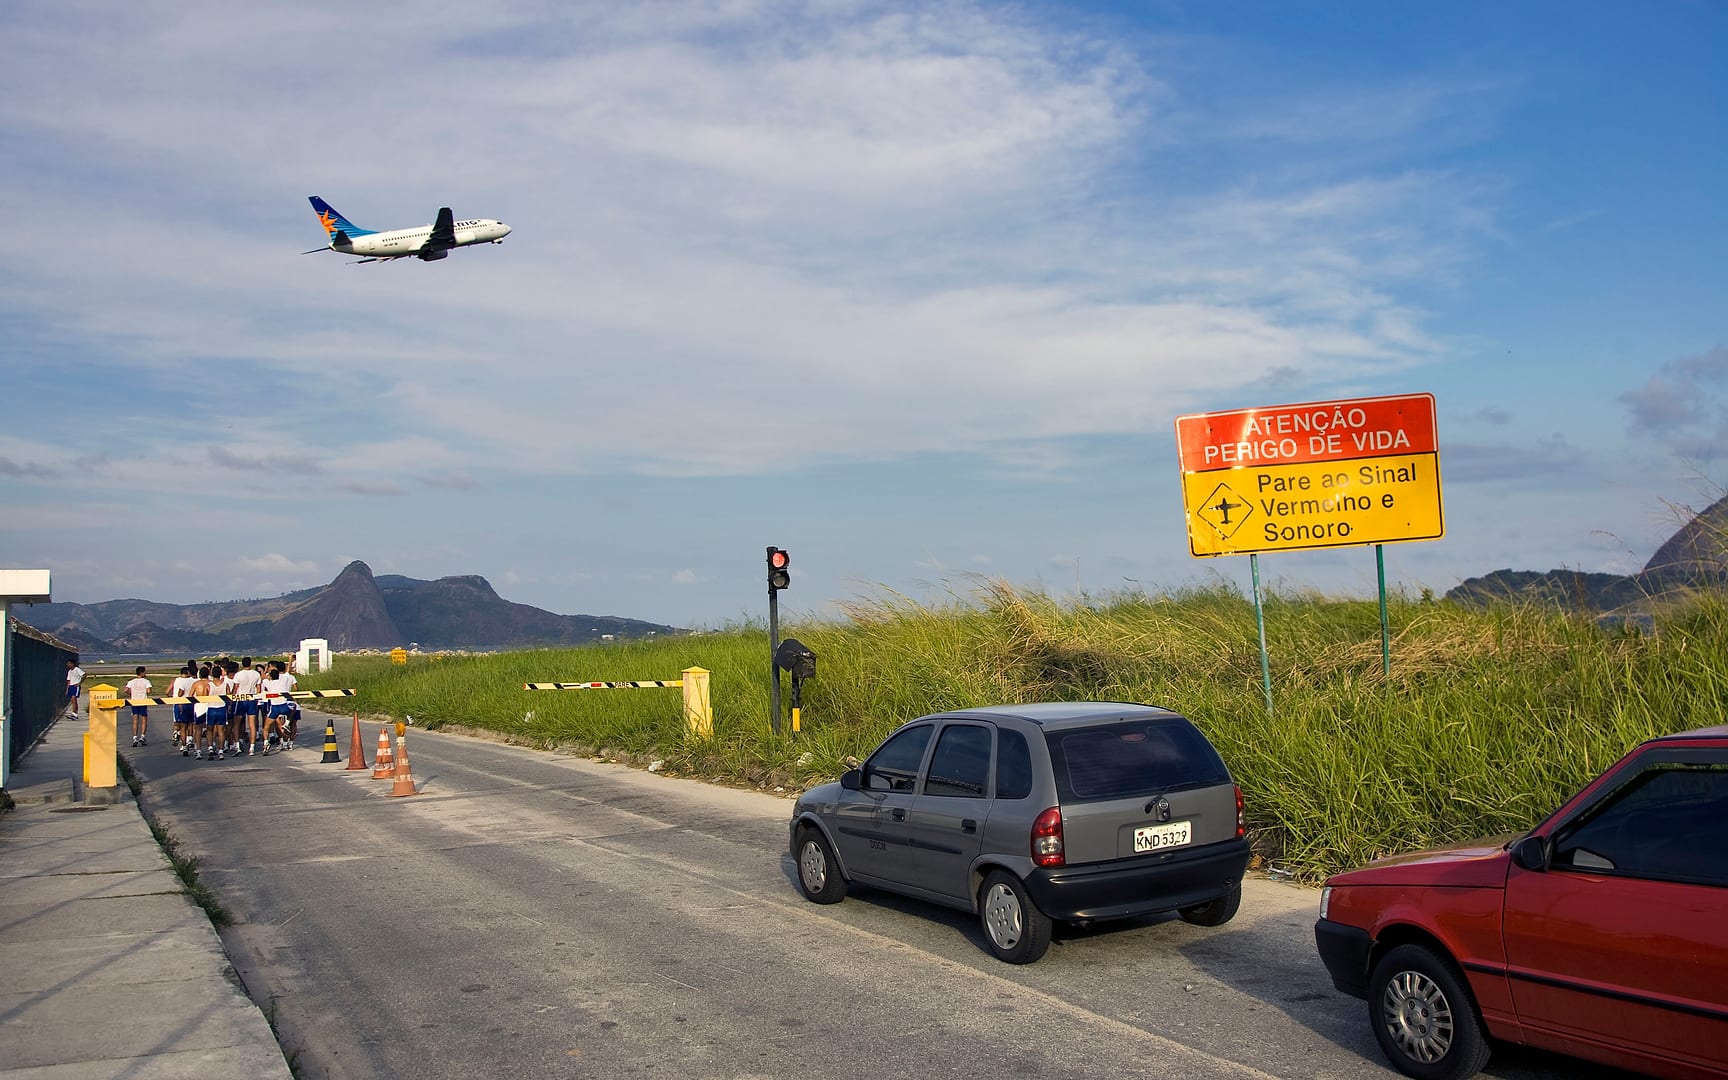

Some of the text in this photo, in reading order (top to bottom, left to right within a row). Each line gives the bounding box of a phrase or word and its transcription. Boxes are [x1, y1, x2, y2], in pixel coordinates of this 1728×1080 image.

[1246, 405, 1366, 436] ATENÇÃO
[1204, 429, 1411, 464] PERIGO DE VIDA
[1257, 463, 1417, 493] Pare ao Sinal
[1261, 493, 1394, 517] Vermelho e
[1264, 522, 1350, 542] Sonoro
[231, 693, 251, 701] PARE
